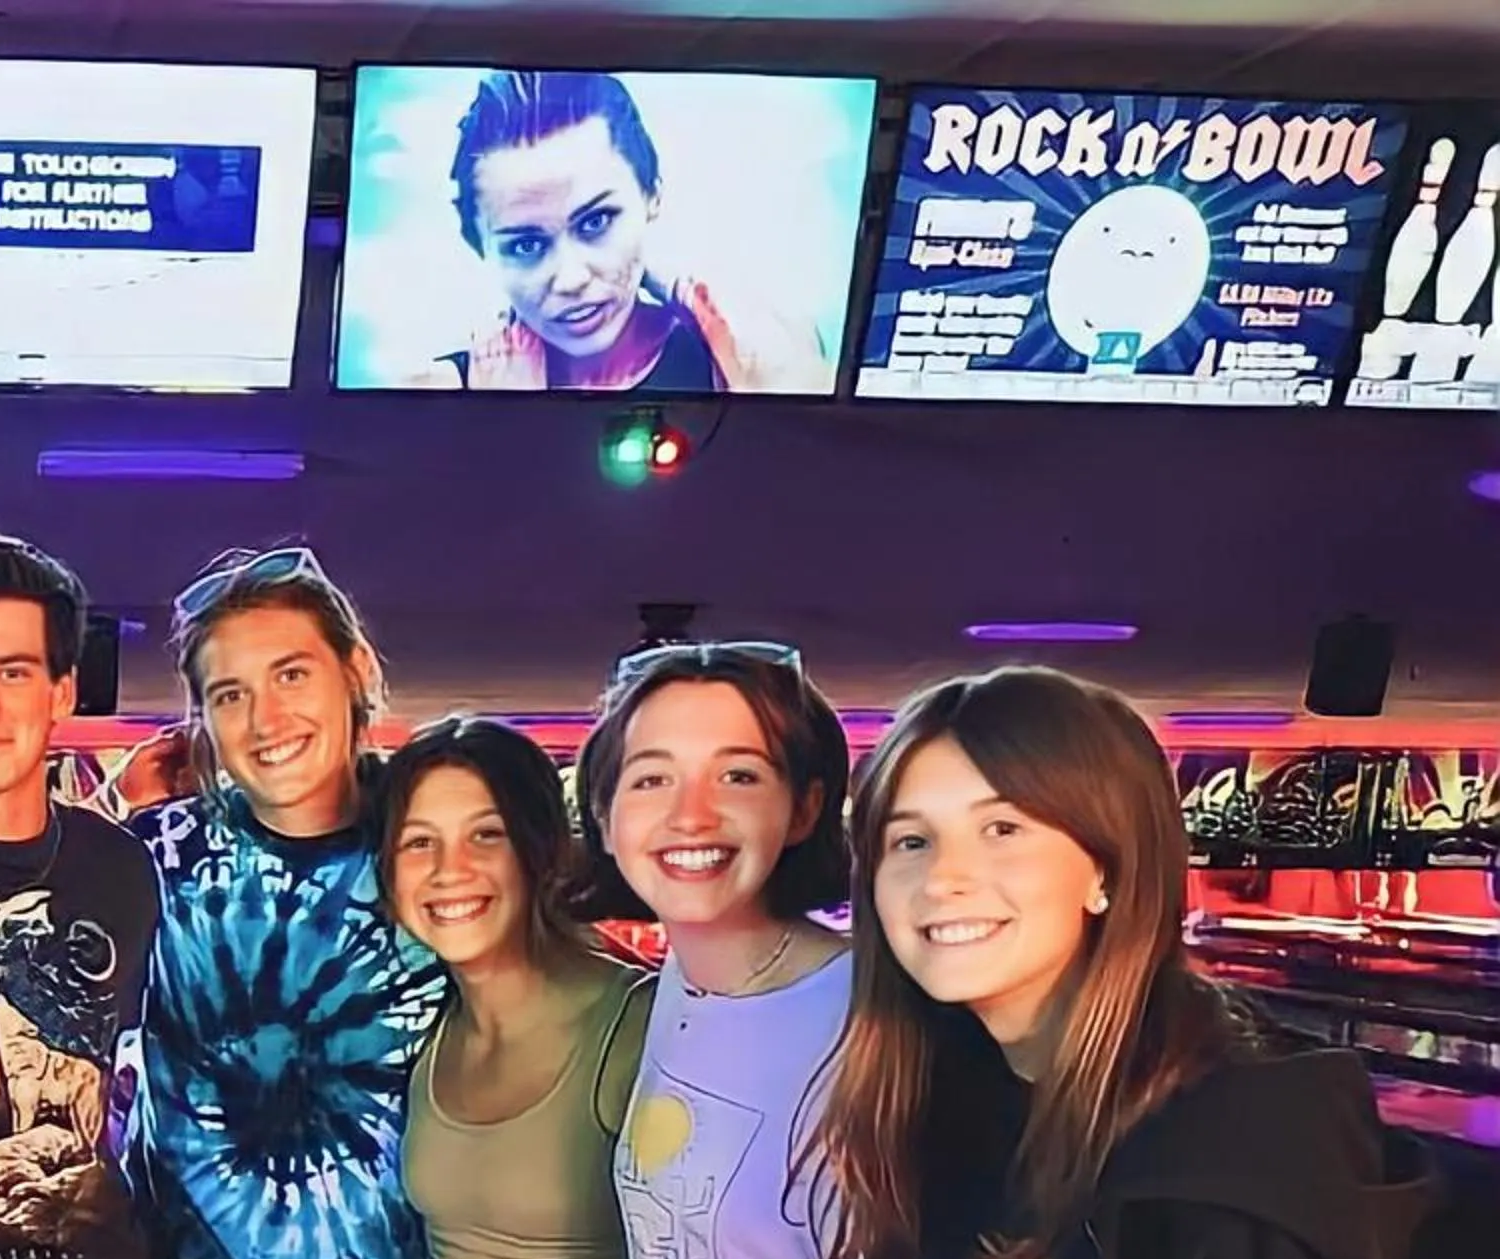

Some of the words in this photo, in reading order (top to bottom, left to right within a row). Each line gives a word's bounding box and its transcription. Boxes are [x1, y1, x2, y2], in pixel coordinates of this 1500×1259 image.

[923, 103, 1116, 176] ROCK
[1182, 116, 1386, 186] BOWL
[52, 181, 148, 205] FURTH
